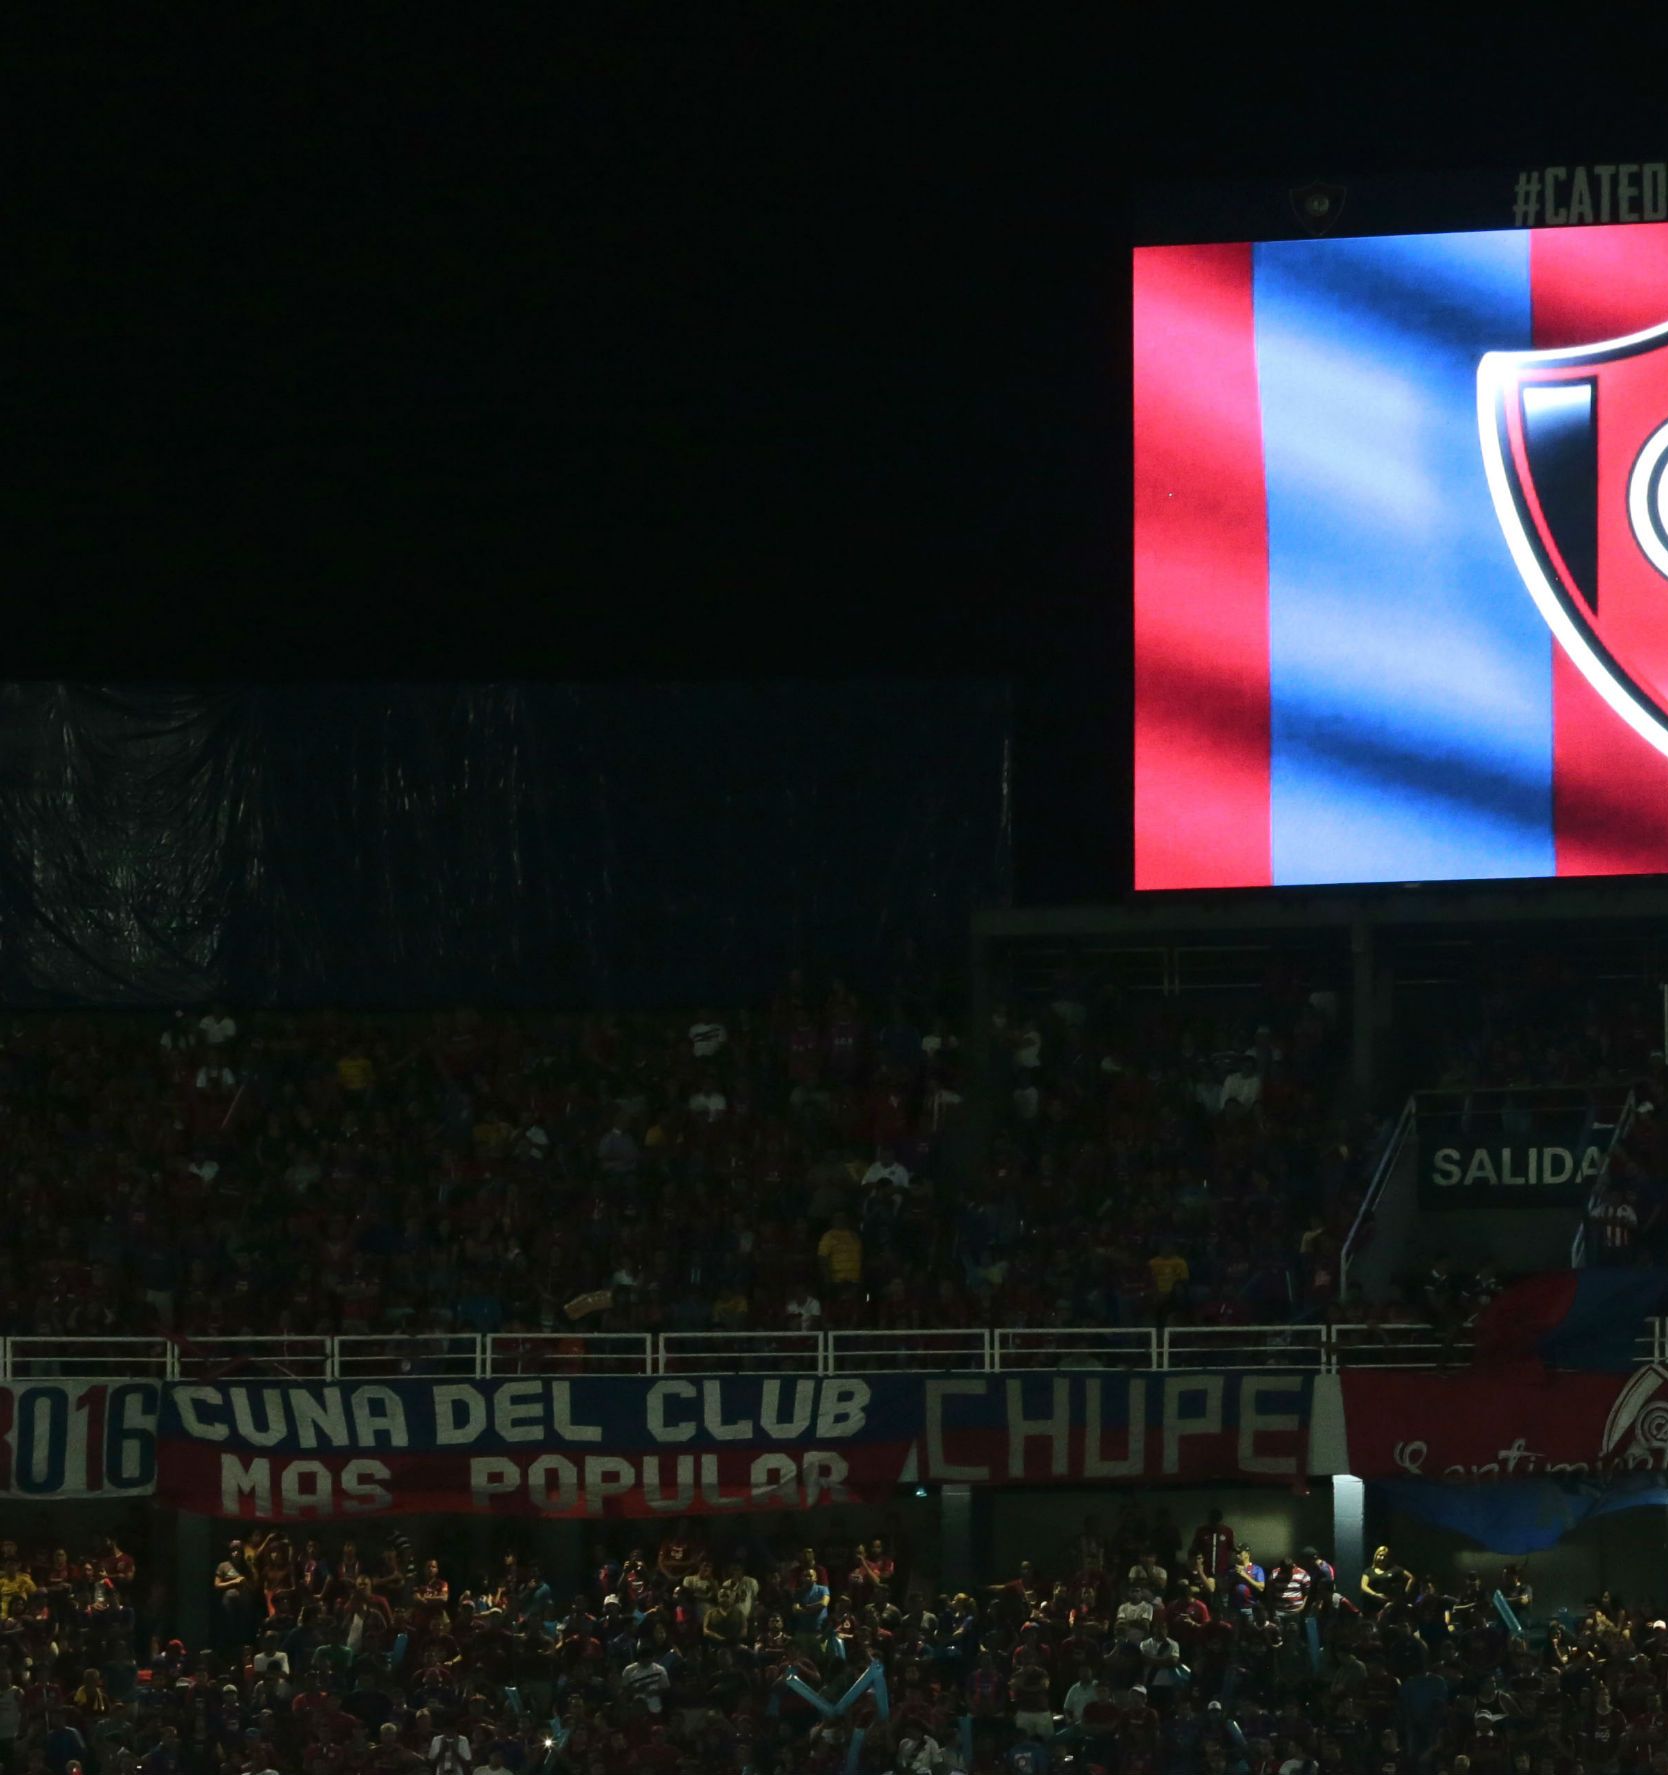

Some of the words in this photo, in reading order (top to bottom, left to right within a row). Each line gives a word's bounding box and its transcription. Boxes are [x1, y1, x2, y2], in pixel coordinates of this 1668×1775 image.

[1432, 1147, 1602, 1186] SALIDA
[0, 1384, 157, 1493] 016
[170, 1384, 410, 1448] CUNA
[432, 1379, 603, 1446] DEL
[646, 1378, 871, 1443] CLUB
[924, 1374, 1305, 1481] CHUPE
[220, 1453, 394, 1516] MAS
[470, 1450, 850, 1514] POPULAR
